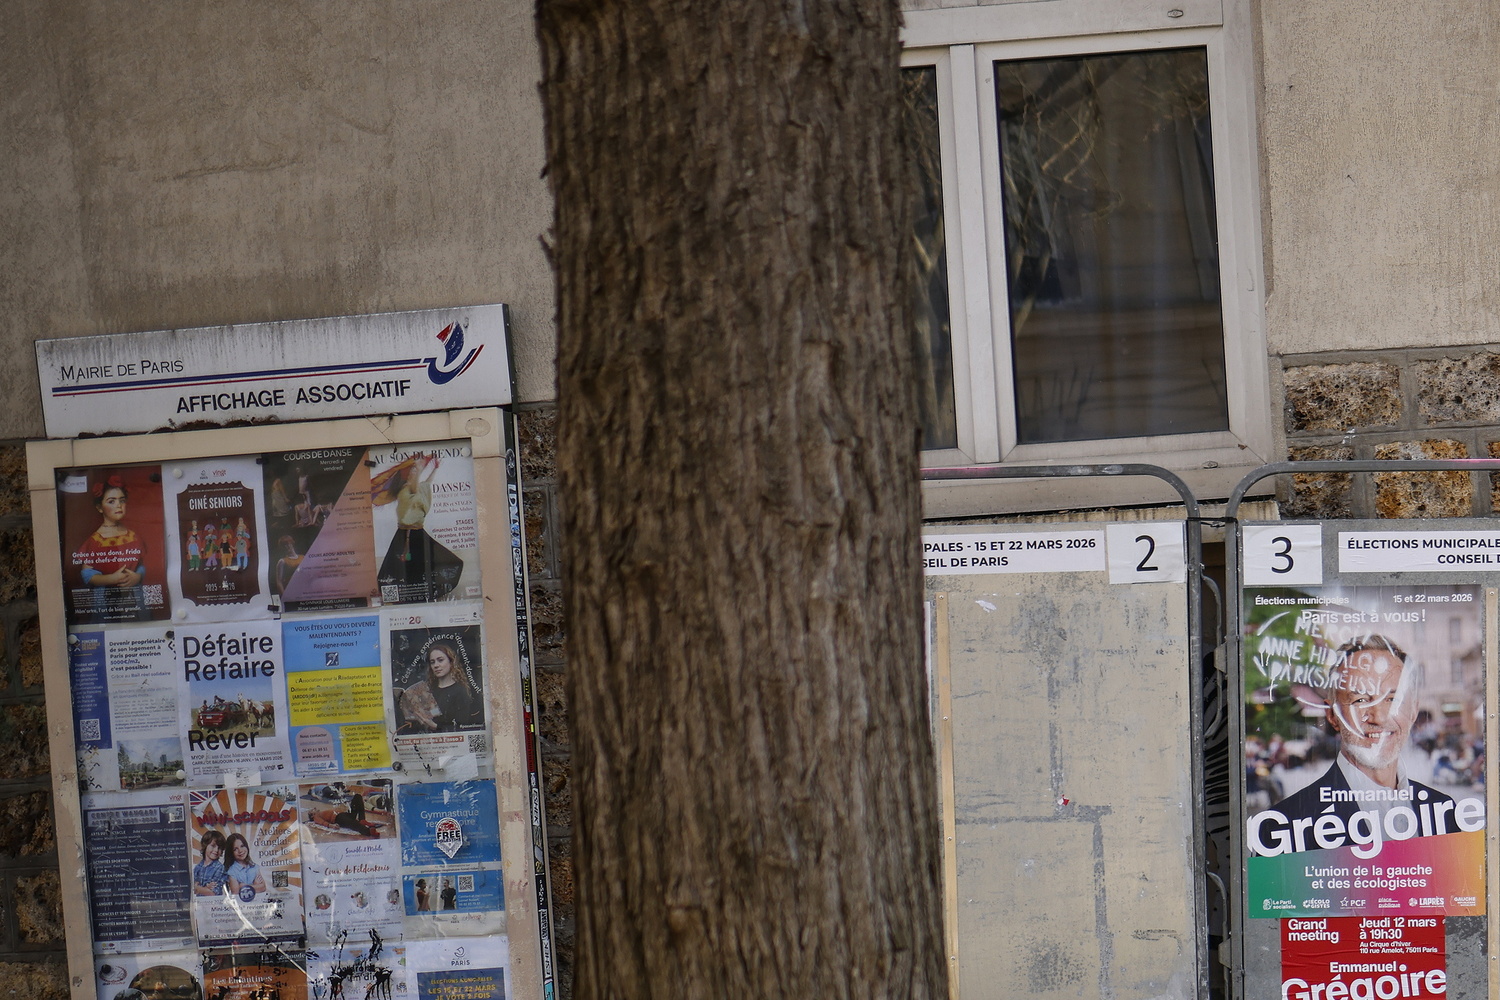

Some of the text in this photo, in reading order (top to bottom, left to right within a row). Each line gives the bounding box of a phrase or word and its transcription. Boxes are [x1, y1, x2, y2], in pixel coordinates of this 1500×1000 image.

[177, 380, 411, 414] AFFICHAGE ASSOCIATIF
[284, 449, 352, 461] COURS DE DANSE
[432, 482, 471, 493] DANSES
[189, 495, 242, 510] CINÉ SENIORS
[923, 539, 1096, 552] PALES 15 ET 22 MARS 2026
[1348, 537, 1419, 550] ÉLECTIONS
[1134, 535, 1159, 572] 2
[1271, 537, 1294, 573] 3
[1438, 554, 1493, 564] CONSEIL
[922, 557, 1008, 568] SEIL DE PARIS
[1302, 611, 1338, 624] Paris
[1343, 611, 1366, 623] est
[1370, 610, 1379, 622] à
[295, 624, 311, 632] VOUS
[311, 622, 322, 631] ÊTES
[132, 638, 165, 646] propriétaire
[309, 631, 357, 640] MALENTENDANTS
[183, 633, 273, 658] Défaire
[185, 655, 274, 681] Refaire
[188, 729, 259, 751] Rêver
[1320, 786, 1413, 803] Emmanuel
[420, 809, 479, 819] Gymnastique
[1248, 790, 1485, 859] Grégoire
[257, 827, 291, 836] Ateliers
[437, 830, 460, 839] FREE
[1305, 864, 1432, 878] L'union de la gauche
[1312, 877, 1426, 890] et des écologistes
[1288, 919, 1326, 930] Grand
[1359, 918, 1436, 928] Jeudi 12 mars
[1288, 930, 1339, 943] meeting
[1360, 929, 1402, 940] à 19h30
[1330, 961, 1396, 972] Emmanuel
